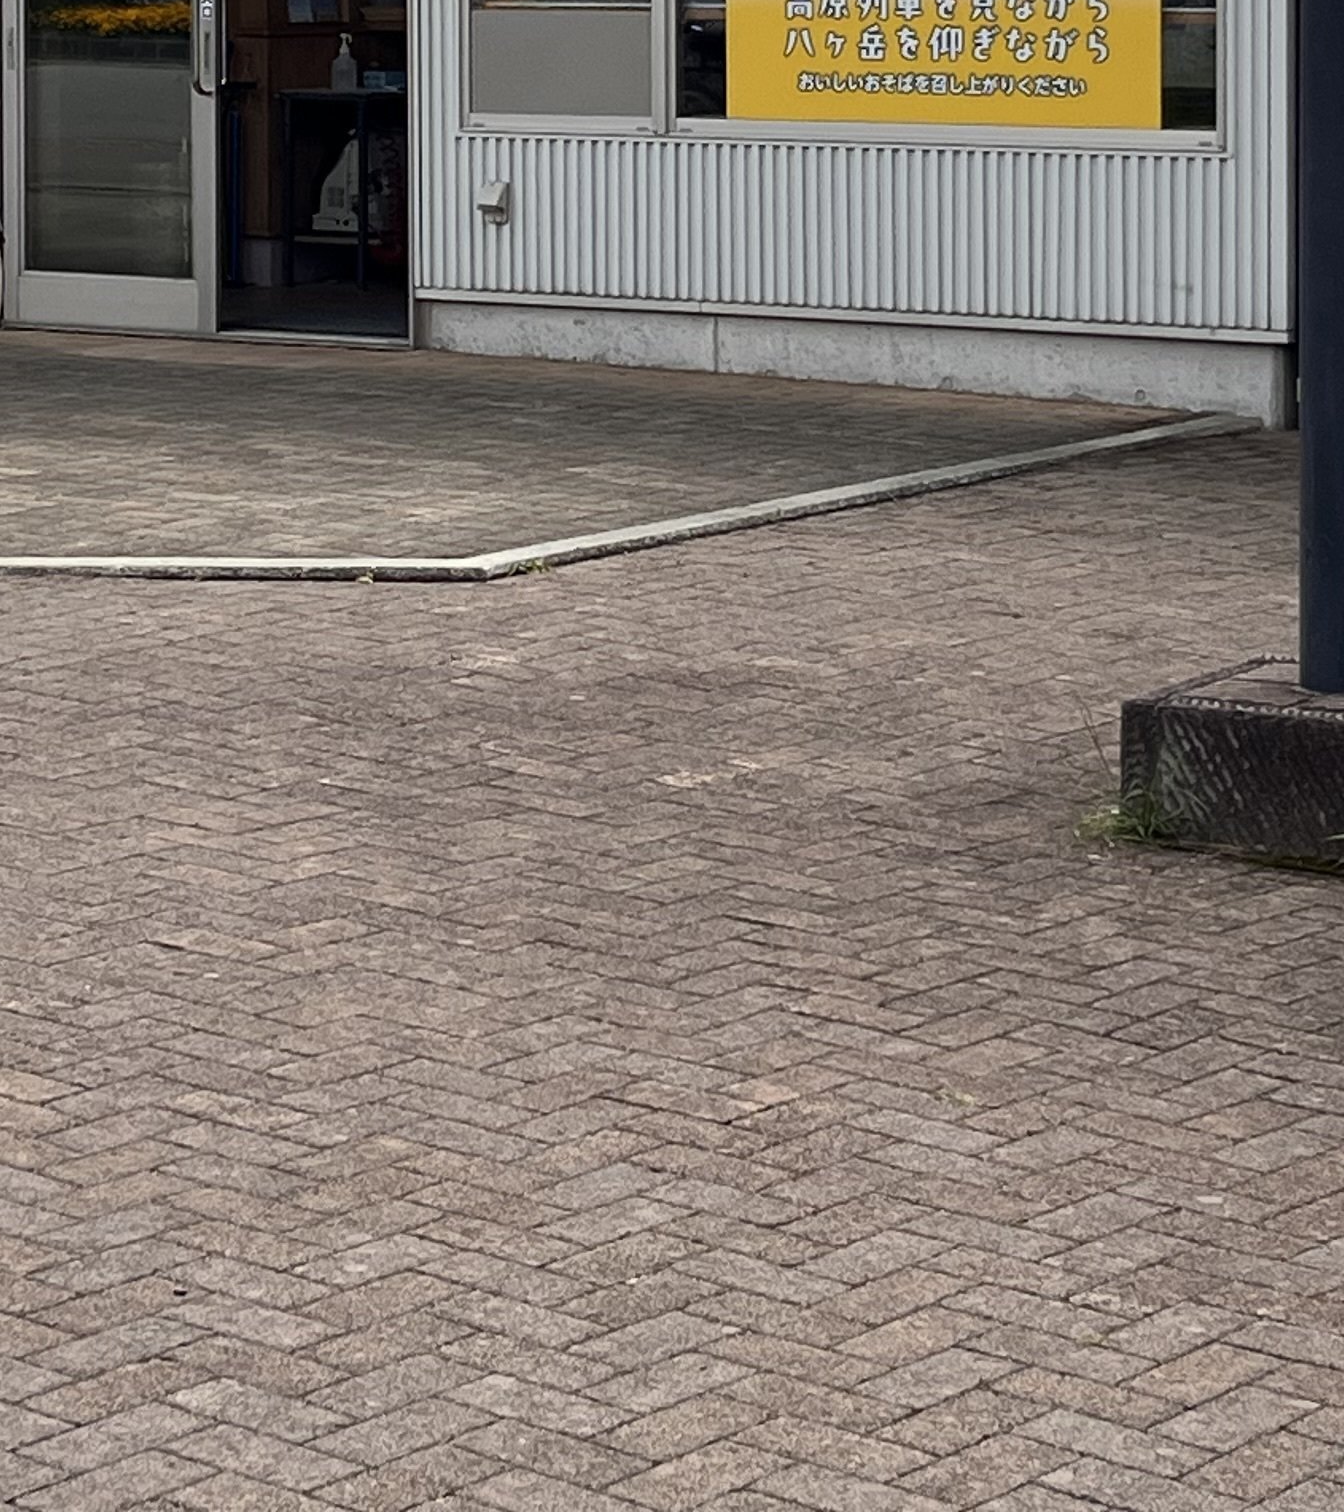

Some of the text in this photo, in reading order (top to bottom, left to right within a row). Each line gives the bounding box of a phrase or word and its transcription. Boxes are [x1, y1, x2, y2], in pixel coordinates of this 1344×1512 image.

[783, 24, 1111, 63] 八ヶ岳を仰ぎながら
[797, 71, 1087, 97] おいしいおそばを召し上がりください
